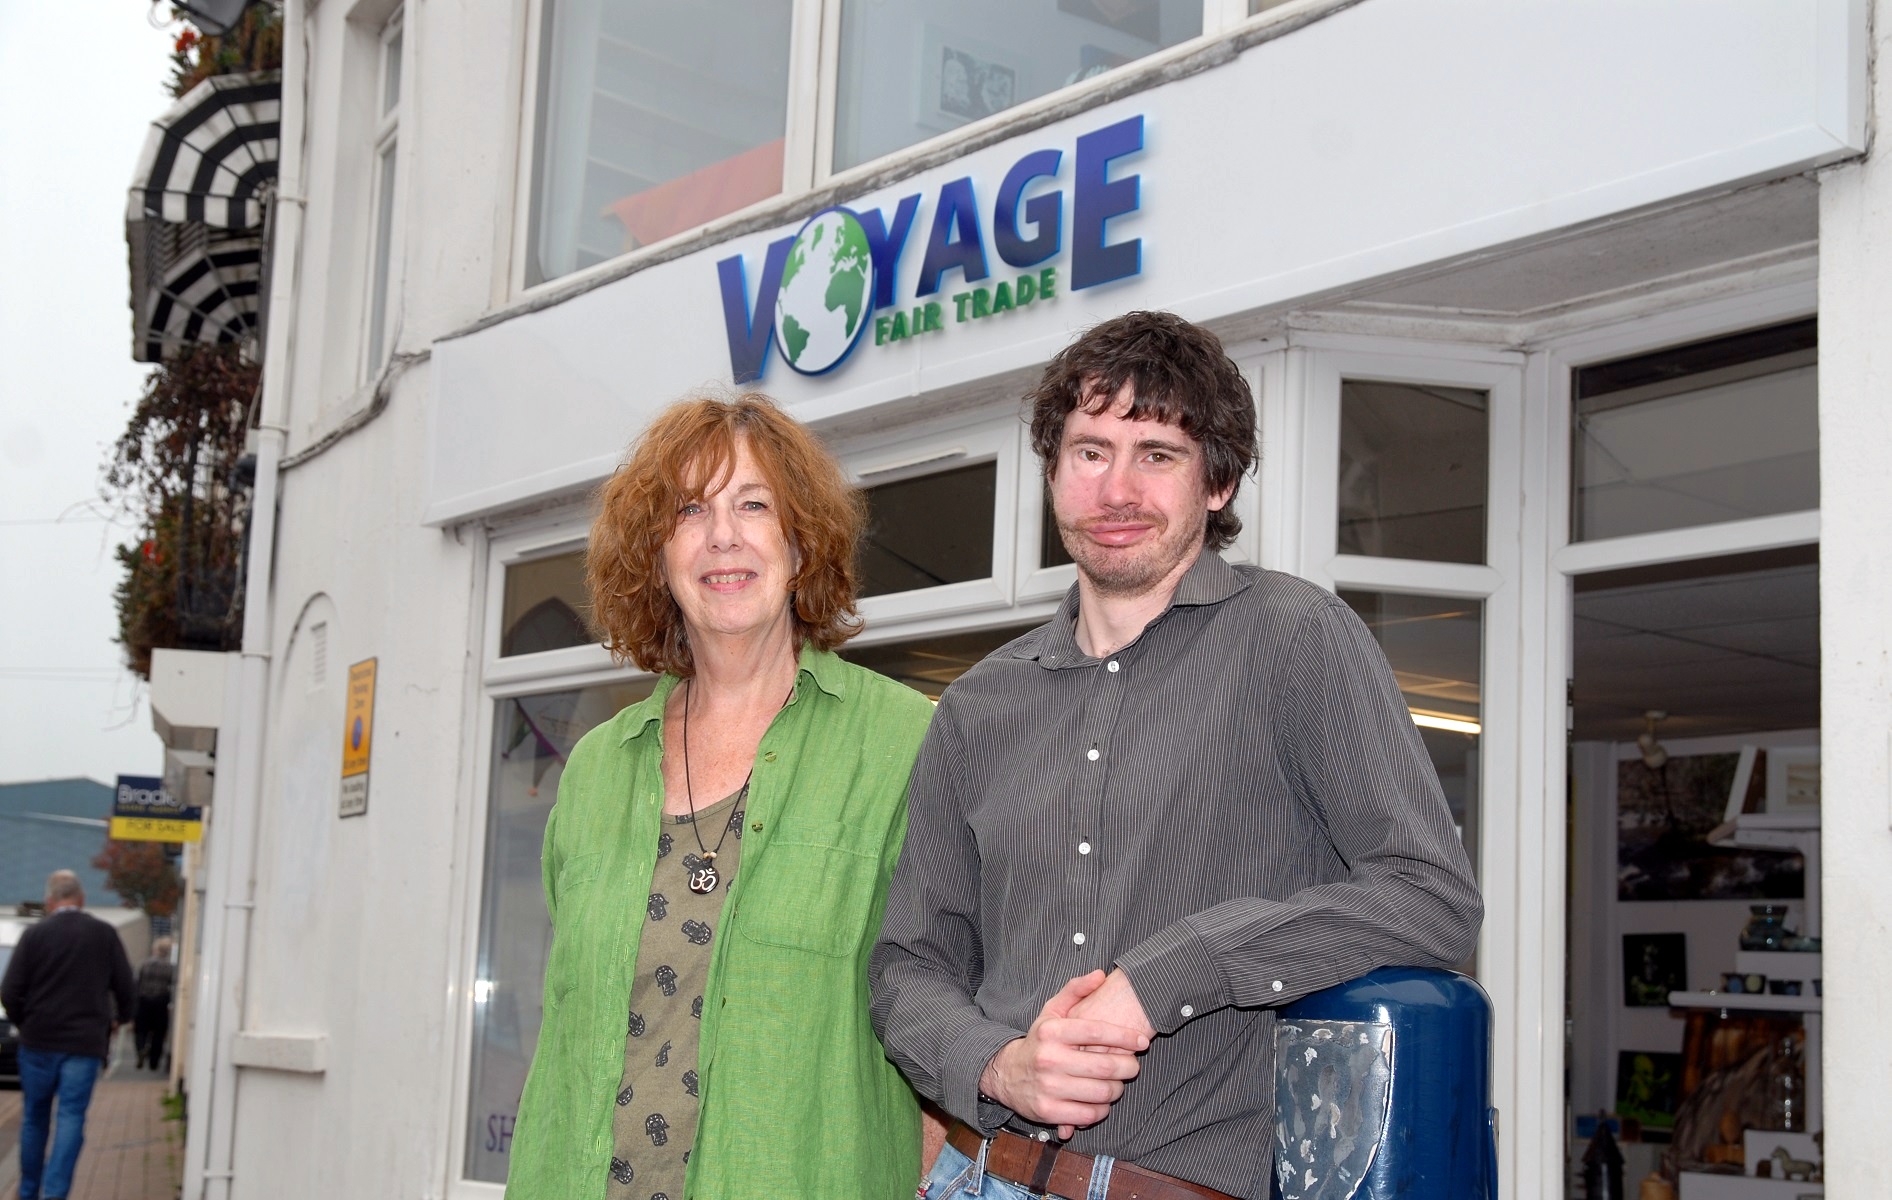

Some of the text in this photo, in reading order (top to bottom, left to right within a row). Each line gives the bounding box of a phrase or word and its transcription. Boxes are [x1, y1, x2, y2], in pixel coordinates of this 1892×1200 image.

[717, 115, 1143, 385] VOYAGE
[875, 266, 1057, 346] FAIR TRADE
